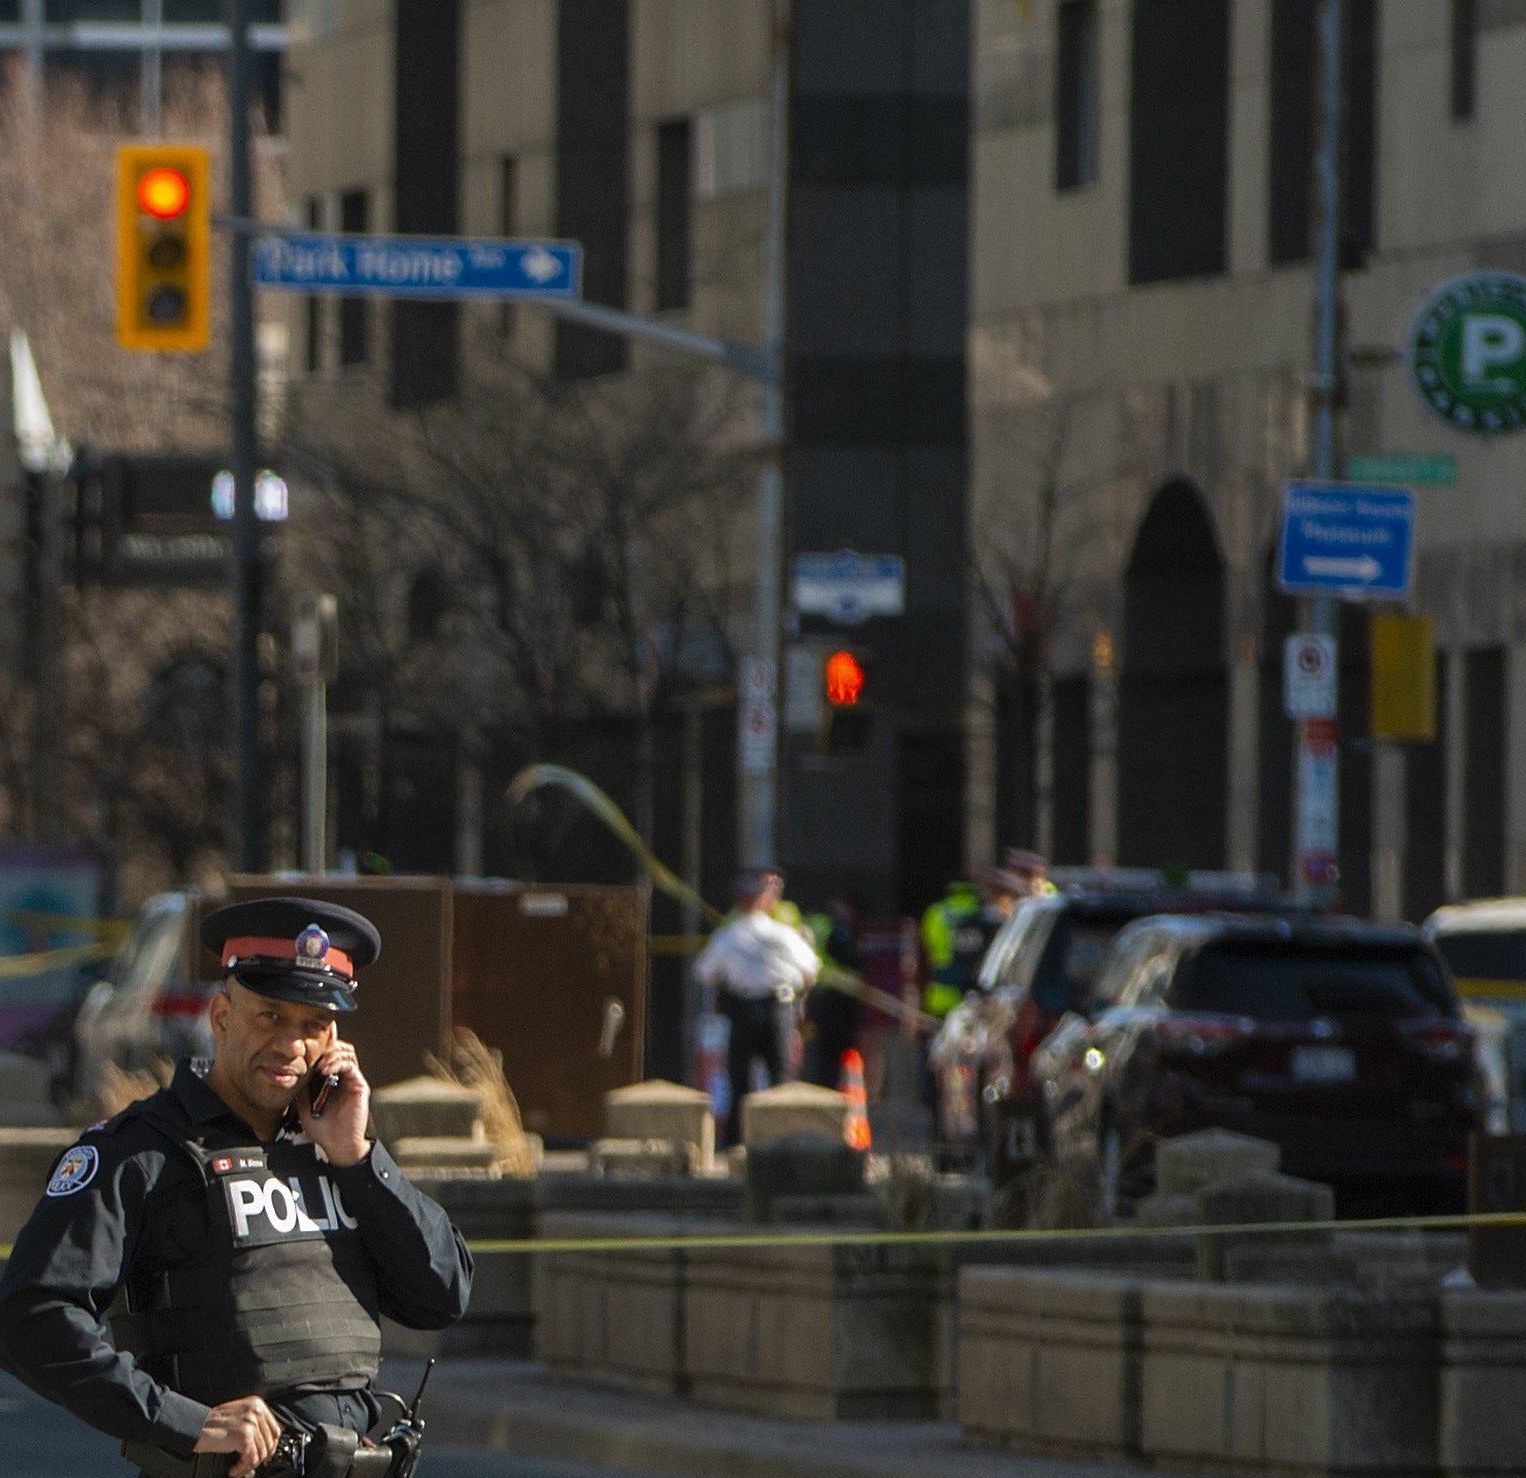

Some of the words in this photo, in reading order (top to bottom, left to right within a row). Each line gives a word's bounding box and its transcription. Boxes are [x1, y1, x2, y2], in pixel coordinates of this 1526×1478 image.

[269, 240, 348, 282] Park
[356, 247, 462, 284] Home
[1463, 315, 1523, 378] P
